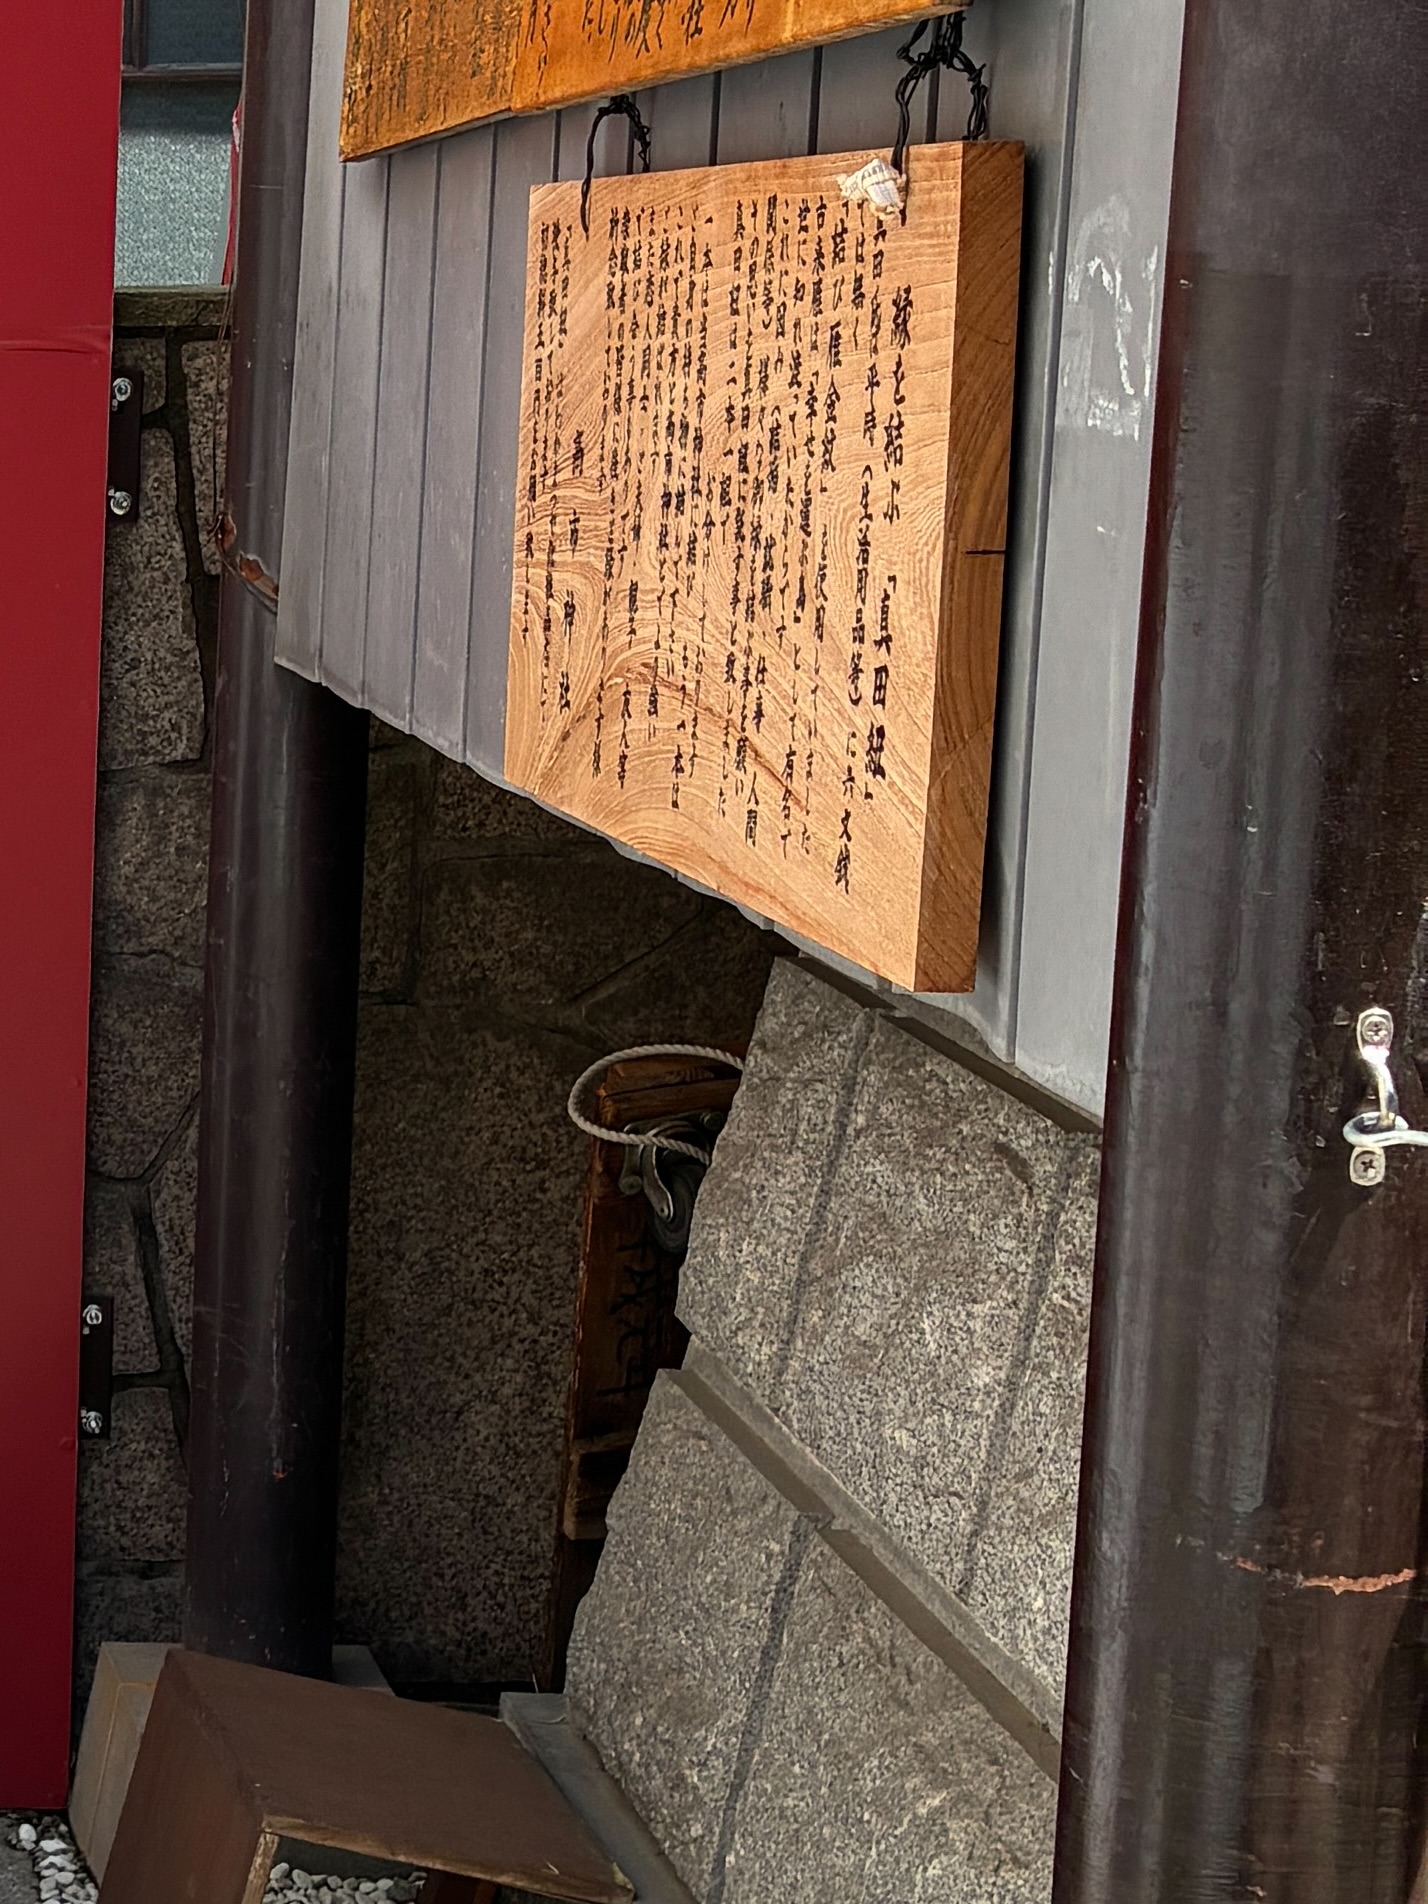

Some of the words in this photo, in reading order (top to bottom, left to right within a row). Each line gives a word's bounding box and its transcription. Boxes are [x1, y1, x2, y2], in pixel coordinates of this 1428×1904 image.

[883, 285, 913, 525] 縁を結ぶ
[864, 575, 897, 800] 「真田紐」
